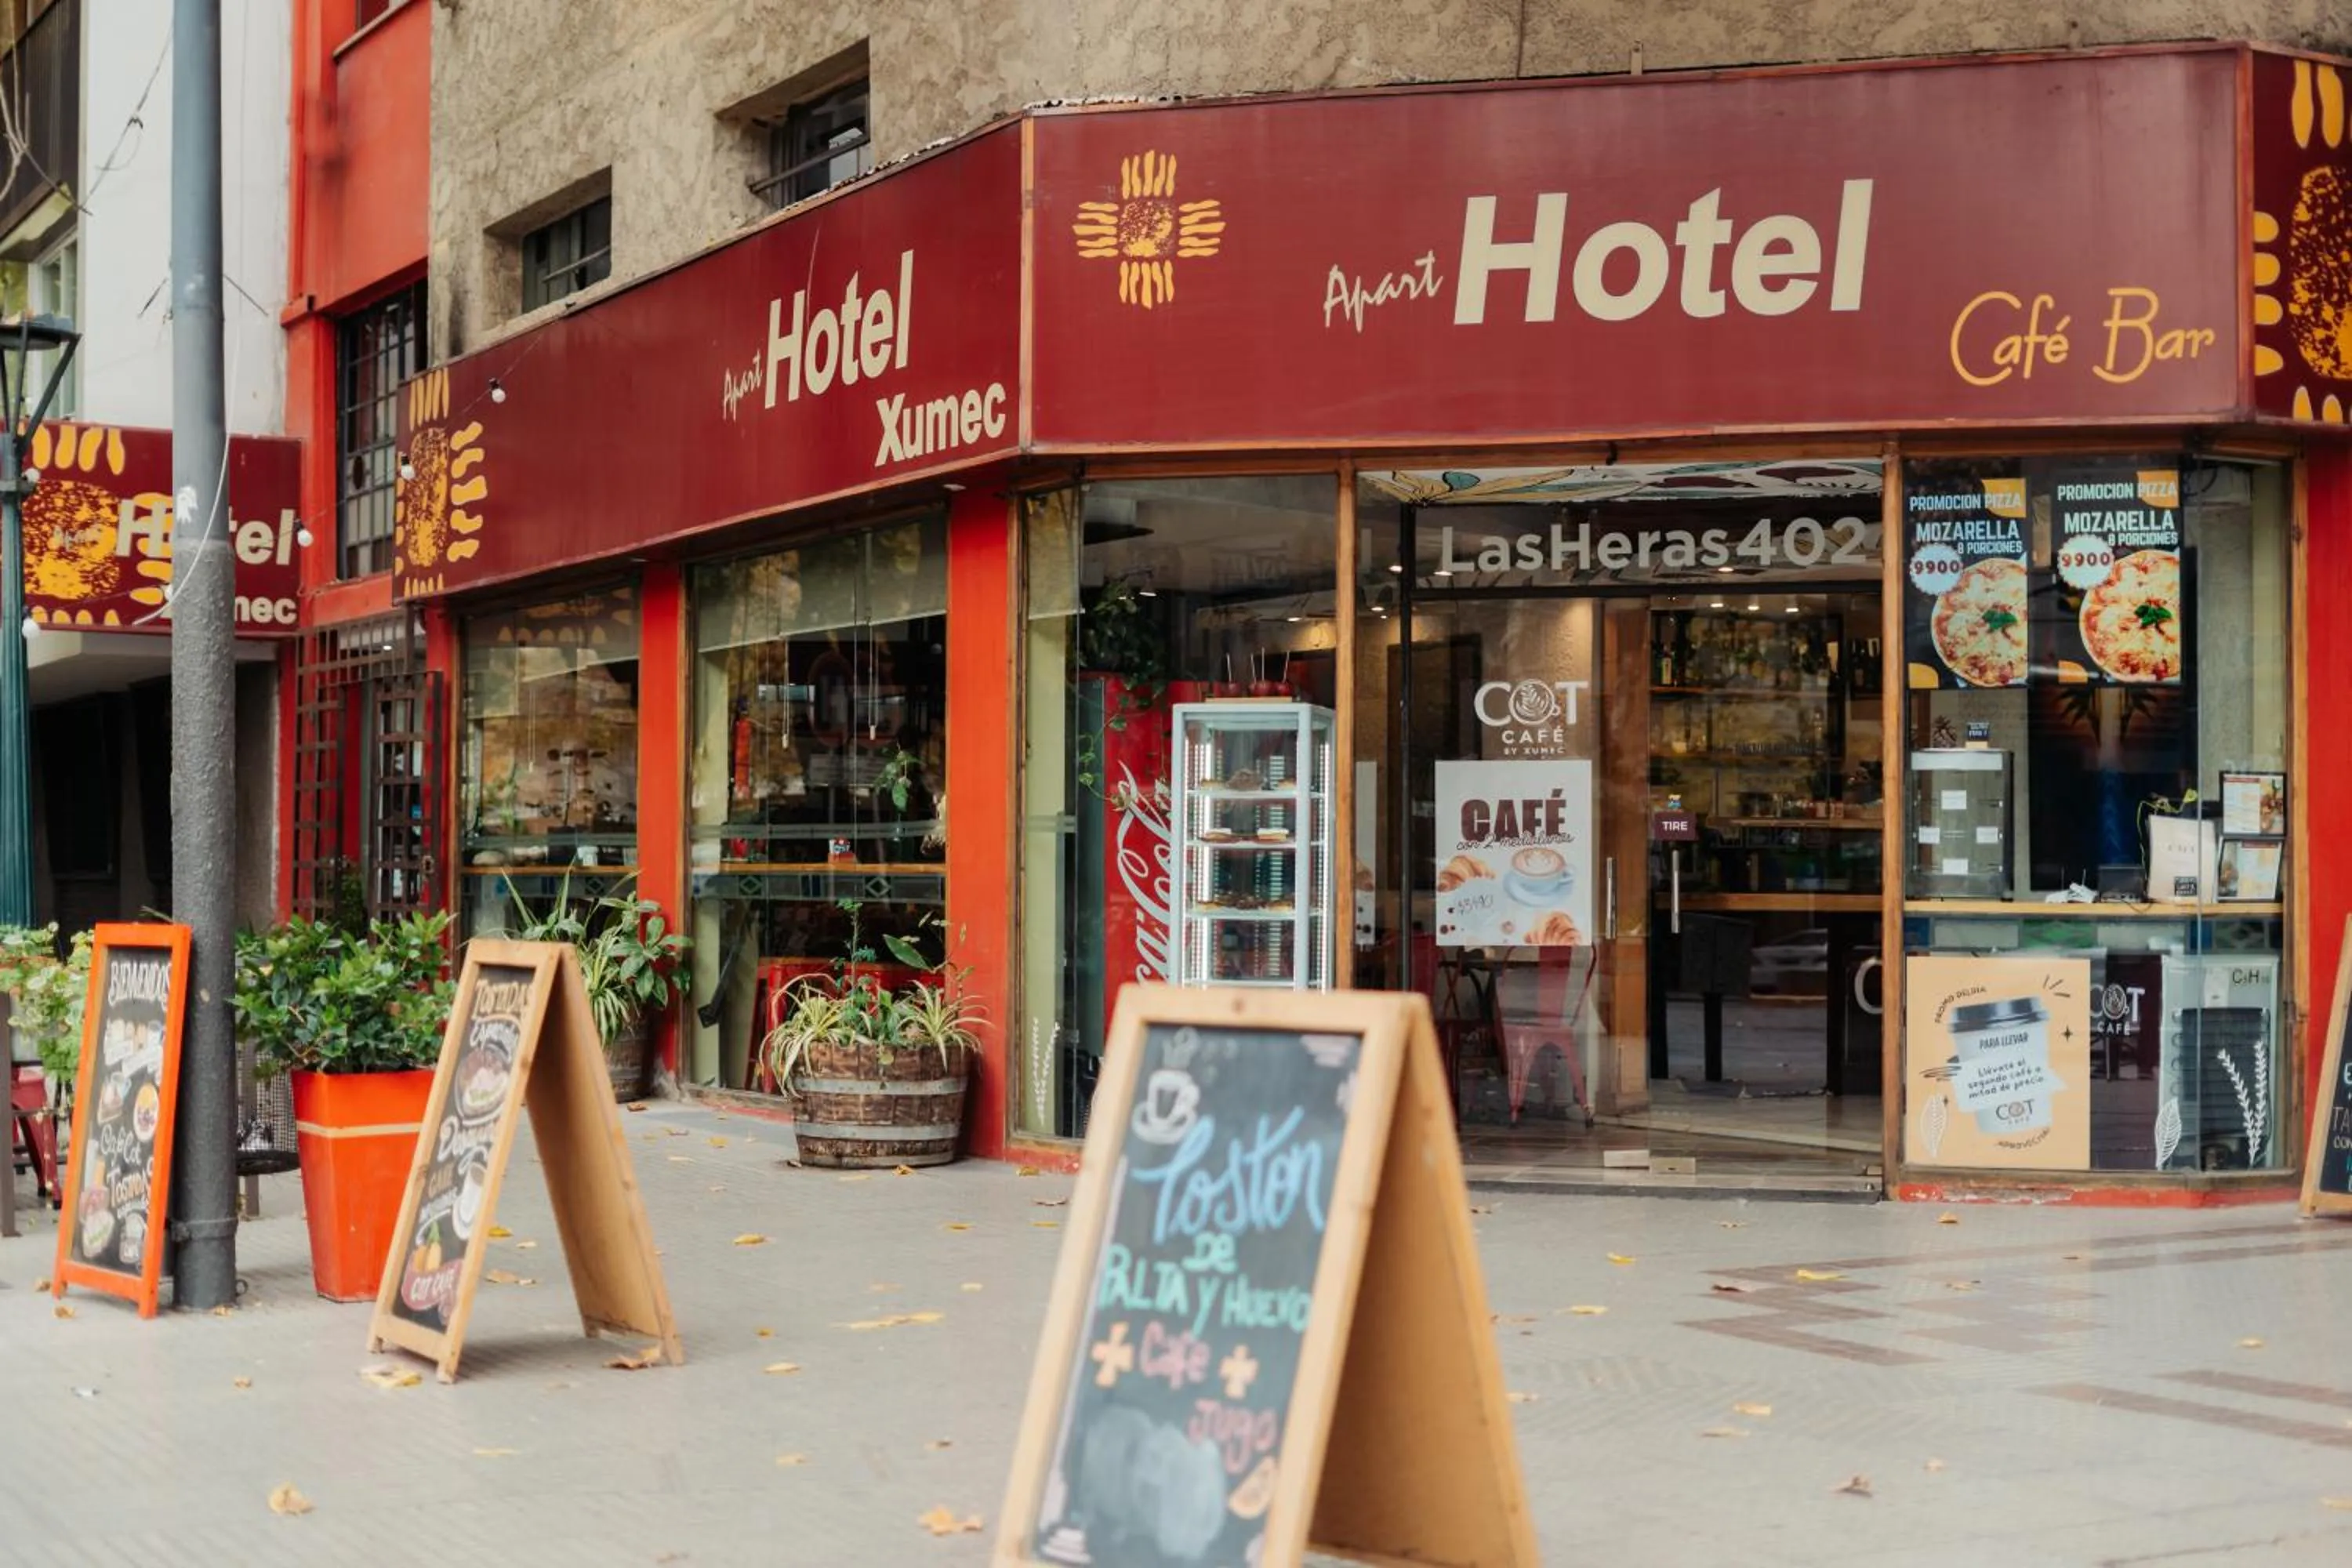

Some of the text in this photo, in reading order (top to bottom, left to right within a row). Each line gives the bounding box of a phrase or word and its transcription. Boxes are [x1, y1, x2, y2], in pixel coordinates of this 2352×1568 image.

[1323, 178, 1874, 332] Apart Hotel
[722, 249, 913, 423] Apart Hotel
[1950, 287, 2216, 386] Café Bar
[874, 383, 1007, 468] Xumec
[2057, 481, 2176, 500] PROMOCION PIZZA
[1909, 492, 2021, 511] PROMOCION PIZZA
[1915, 520, 2020, 542] MOZARELLA
[2064, 510, 2175, 533] MOZARELLA
[116, 499, 296, 565] Hel
[2118, 532, 2178, 546] PORCIONES
[1967, 541, 2023, 554] PORCIONES
[1914, 560, 1960, 575] 9900
[2061, 552, 2111, 568] 9900
[1474, 679, 1589, 727] COT
[1501, 726, 1565, 744] CAFÉ
[1461, 789, 1566, 843] CAFÉ
[1662, 821, 1688, 832] TIRE
[2096, 1020, 2131, 1036] CAFÉ
[1979, 1032, 2029, 1050] PARA LLEVAR
